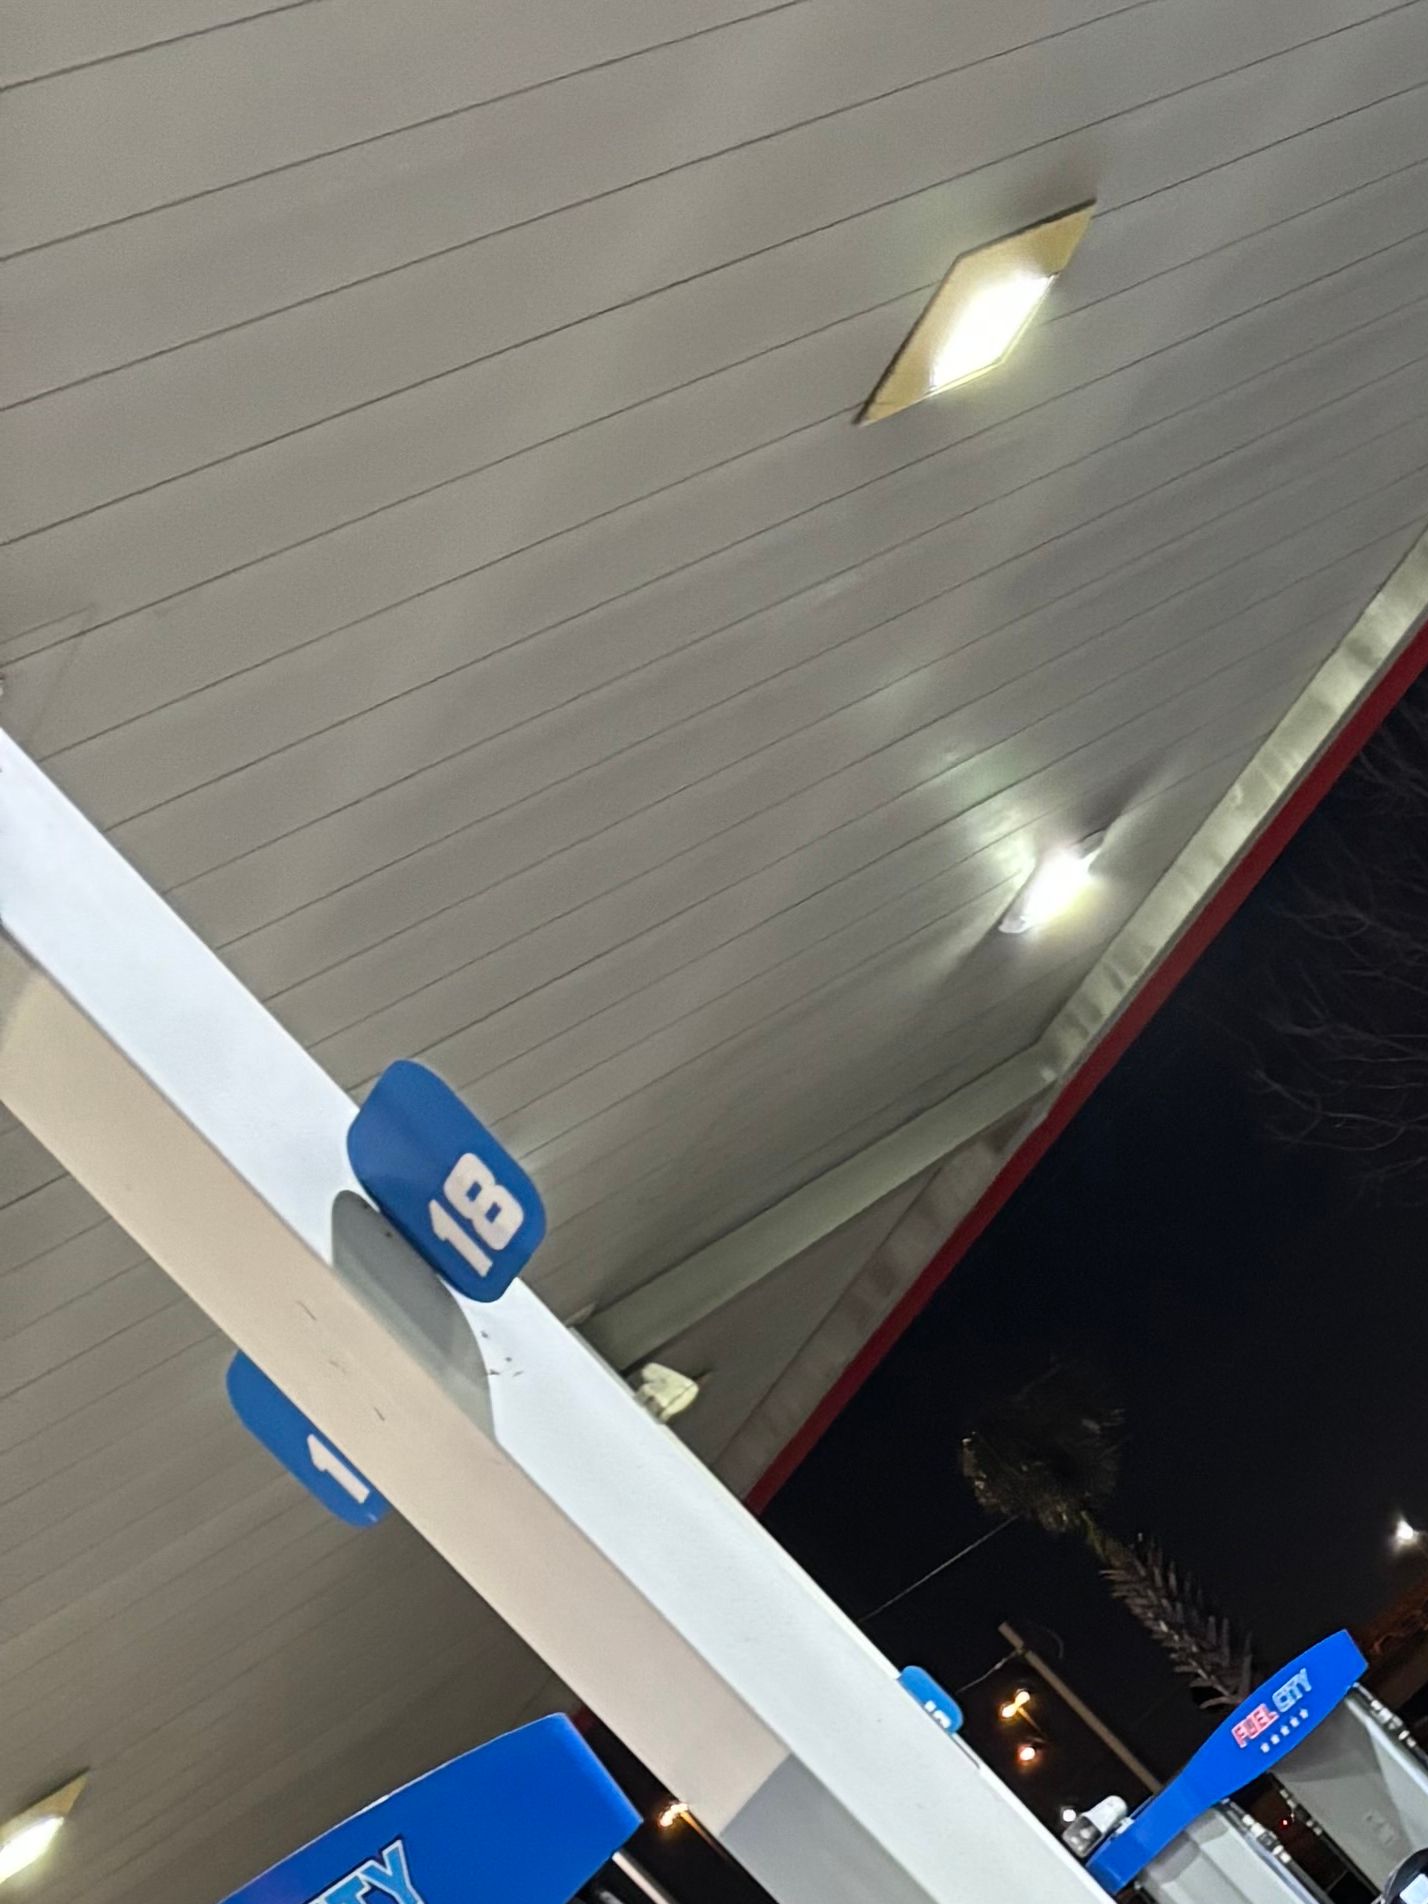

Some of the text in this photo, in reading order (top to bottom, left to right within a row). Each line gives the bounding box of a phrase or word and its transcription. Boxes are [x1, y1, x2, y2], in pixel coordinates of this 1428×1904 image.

[427, 1152, 525, 1278] 18
[1231, 1667, 1312, 1748] FUEL CITY
